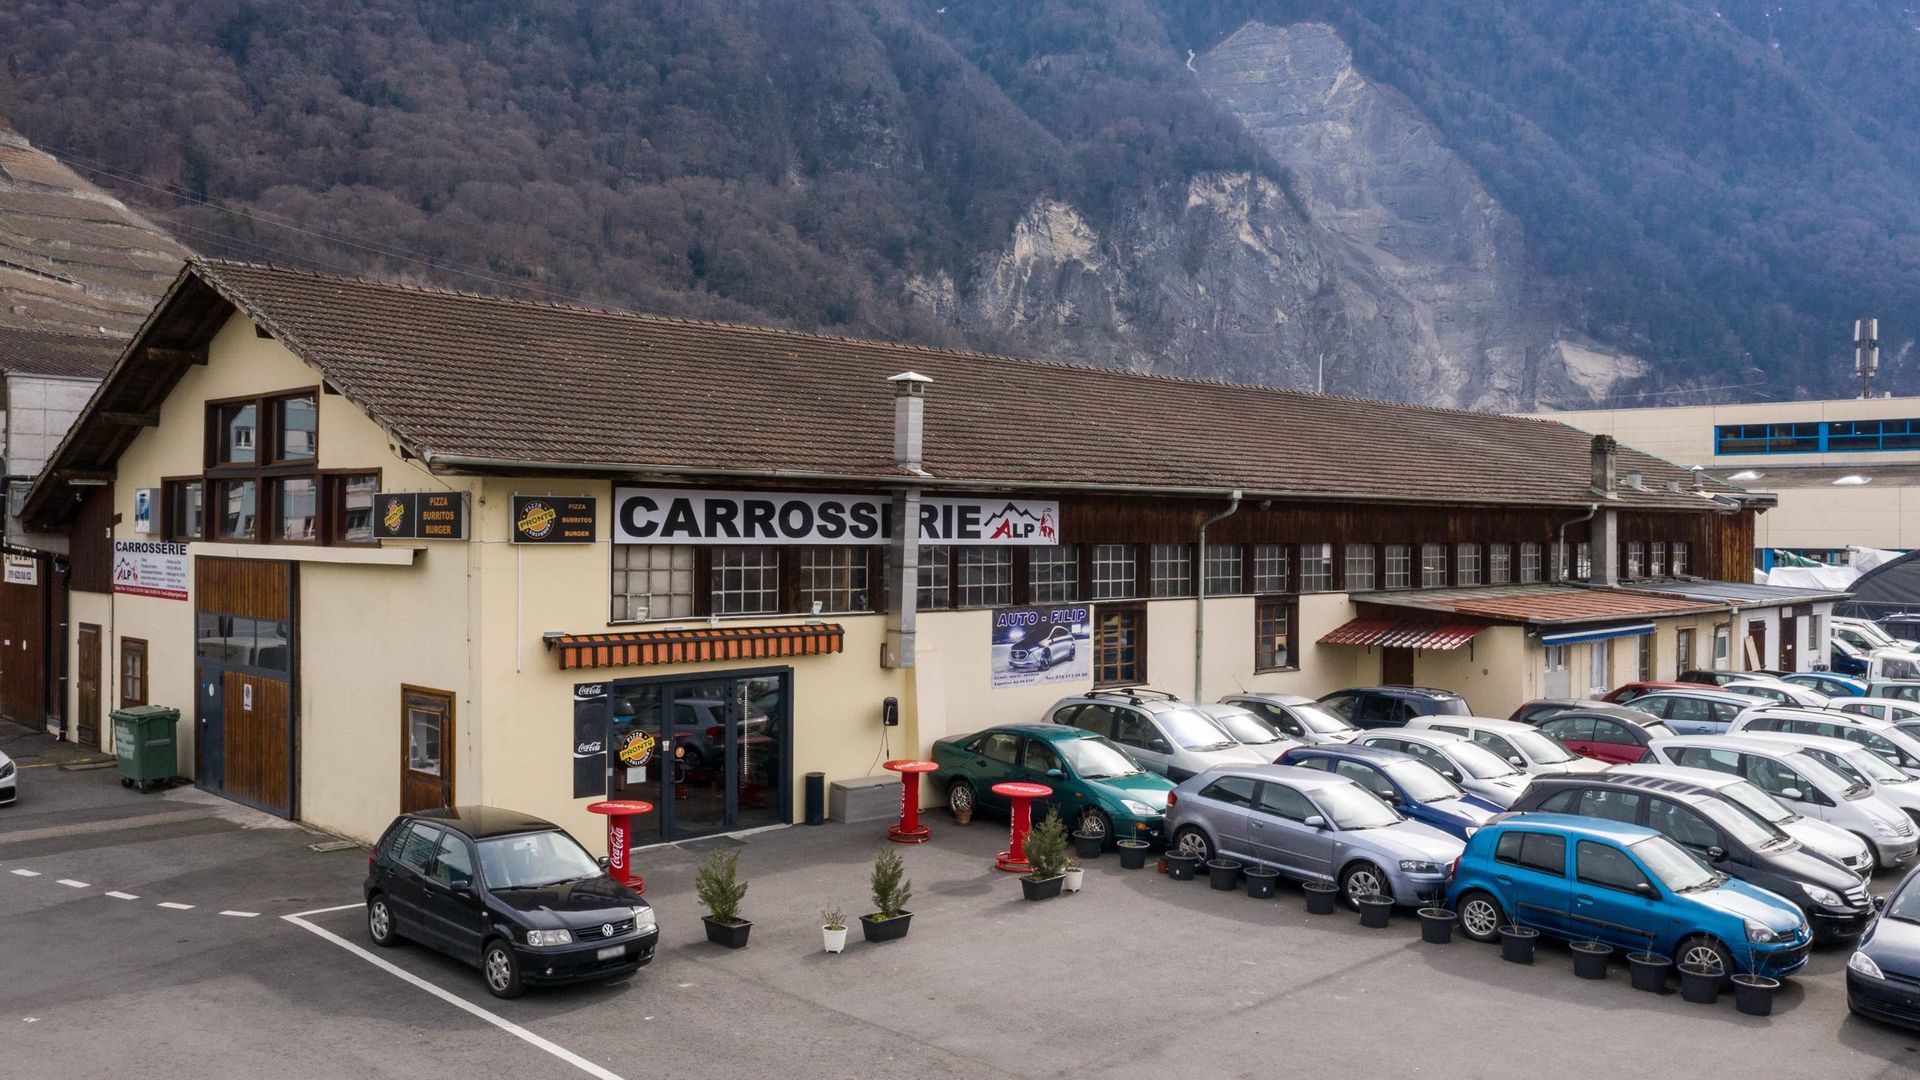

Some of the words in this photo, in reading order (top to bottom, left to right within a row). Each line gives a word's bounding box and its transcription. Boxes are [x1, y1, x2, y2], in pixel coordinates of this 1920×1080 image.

[429, 496, 448, 506] PIZZA
[525, 502, 542, 513] PIZZA
[423, 511, 455, 520] BURRITOS
[519, 510, 554, 529] PRONTO
[425, 525, 452, 534] BURGER
[990, 518, 1035, 539] ALP
[115, 541, 187, 555] CARROSSERIE
[996, 611, 1038, 627] AUTO
[1050, 608, 1087, 624] FILIP
[578, 684, 602, 695] Coca-Cola
[578, 741, 602, 753] Coca-Cola
[621, 739, 653, 758] PRONTO
[610, 824, 624, 869] Coca-Cola
